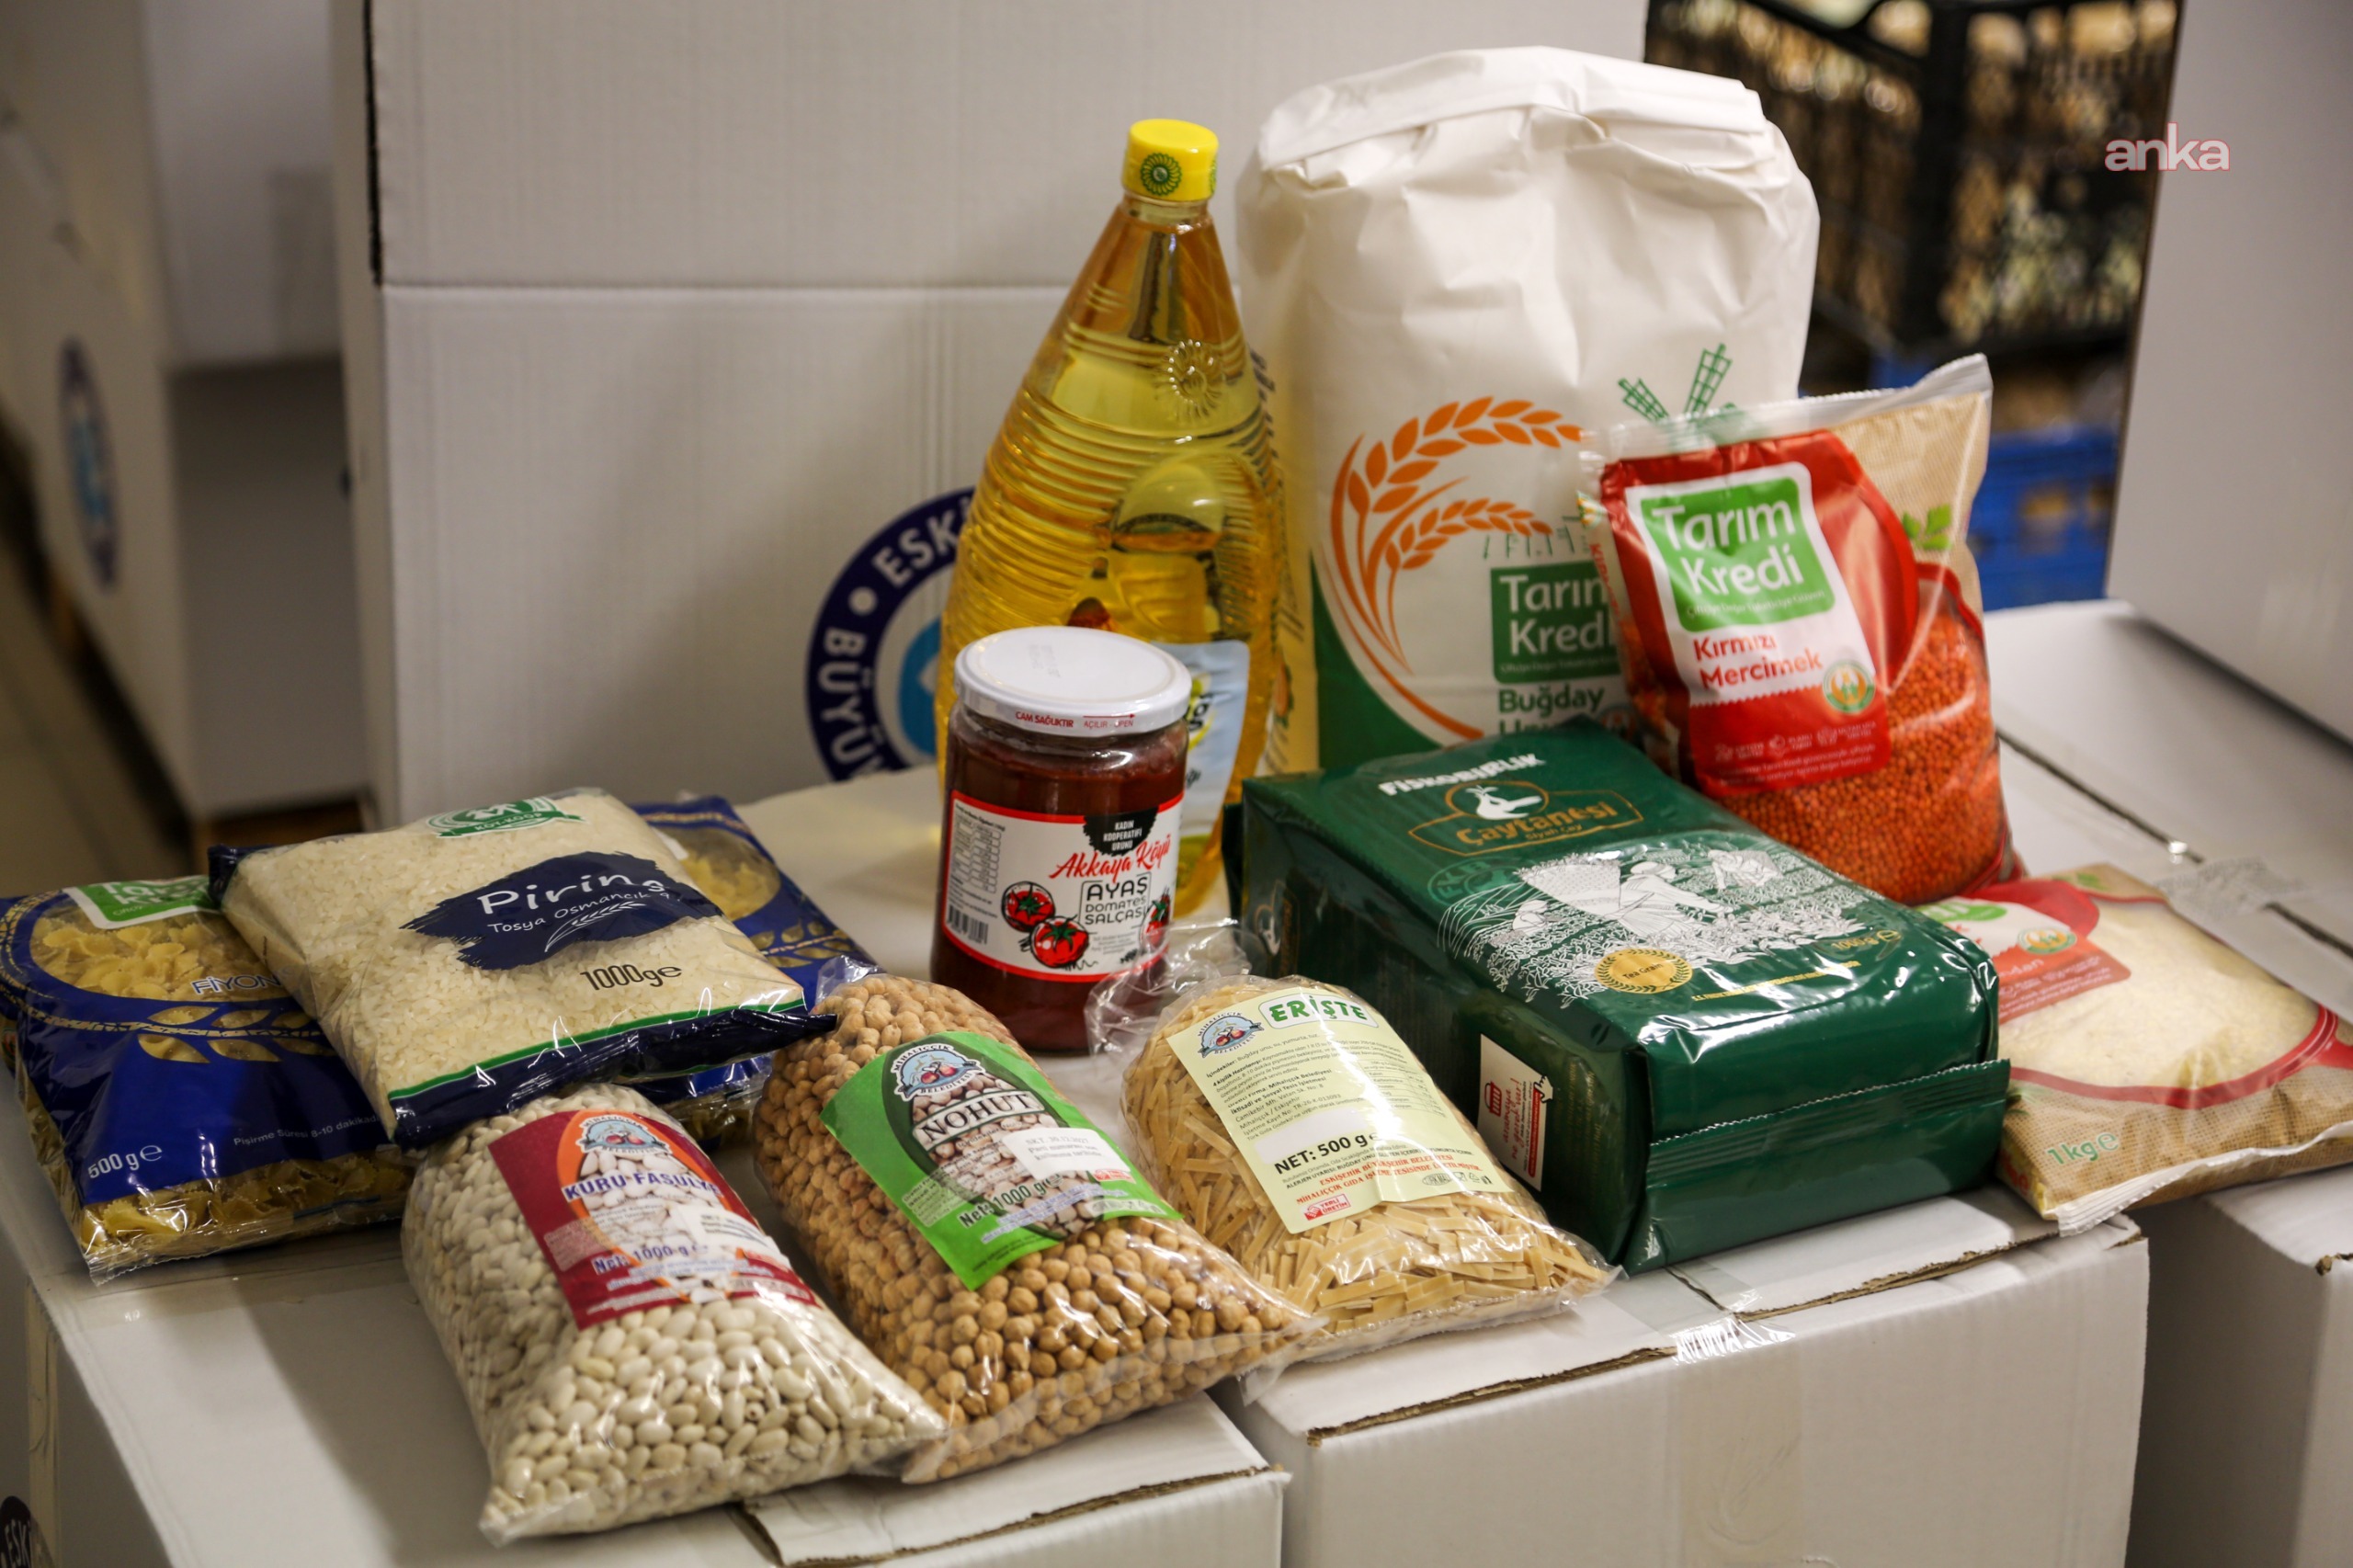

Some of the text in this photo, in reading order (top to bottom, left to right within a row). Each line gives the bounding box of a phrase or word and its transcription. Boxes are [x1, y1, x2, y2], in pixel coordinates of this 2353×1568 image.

[1651, 496, 1796, 553] Tarım
[1678, 542, 1804, 598] Kredi
[1692, 633, 1779, 663] Kırmızı
[1698, 646, 1824, 691] Mercimek
[817, 626, 884, 775] BÜYÜ
[1498, 683, 1605, 718] Buğday
[1015, 711, 1034, 722] CAM
[1115, 820, 1134, 830] KADIN
[1049, 834, 1171, 884] Akkaya Köyü
[1086, 876, 1149, 902] AYAŞ
[487, 916, 546, 933] Tosya
[554, 891, 652, 918] Osmancık
[191, 975, 281, 995] FİYON
[1622, 960, 1665, 981] Tea Grain
[1268, 994, 1367, 1023] ERİŞTE
[1237, 1050, 1259, 1062] Buğday
[1301, 1068, 1333, 1079] Belediyesi
[1262, 1088, 1282, 1100] Sosyal
[921, 1092, 1036, 1142] NOHUT
[233, 1132, 275, 1146] Pişirme
[311, 1125, 334, 1138] 8-10
[87, 1153, 123, 1179] 500
[1274, 1150, 1316, 1175] NET:
[1317, 1136, 1351, 1157] 500
[563, 1172, 723, 1200] KURU FASULYE
[1287, 1176, 1313, 1189] ALERJEN
[1337, 1158, 1361, 1170] BUĞDAY
[1319, 1168, 1361, 1186] ESKİŞEHİR
[1344, 1176, 1364, 1188] GIDA
[960, 1203, 995, 1228] Net:
[993, 1185, 1032, 1210] 1000
[593, 1256, 630, 1274] Net:
[633, 1244, 673, 1262] 1000
